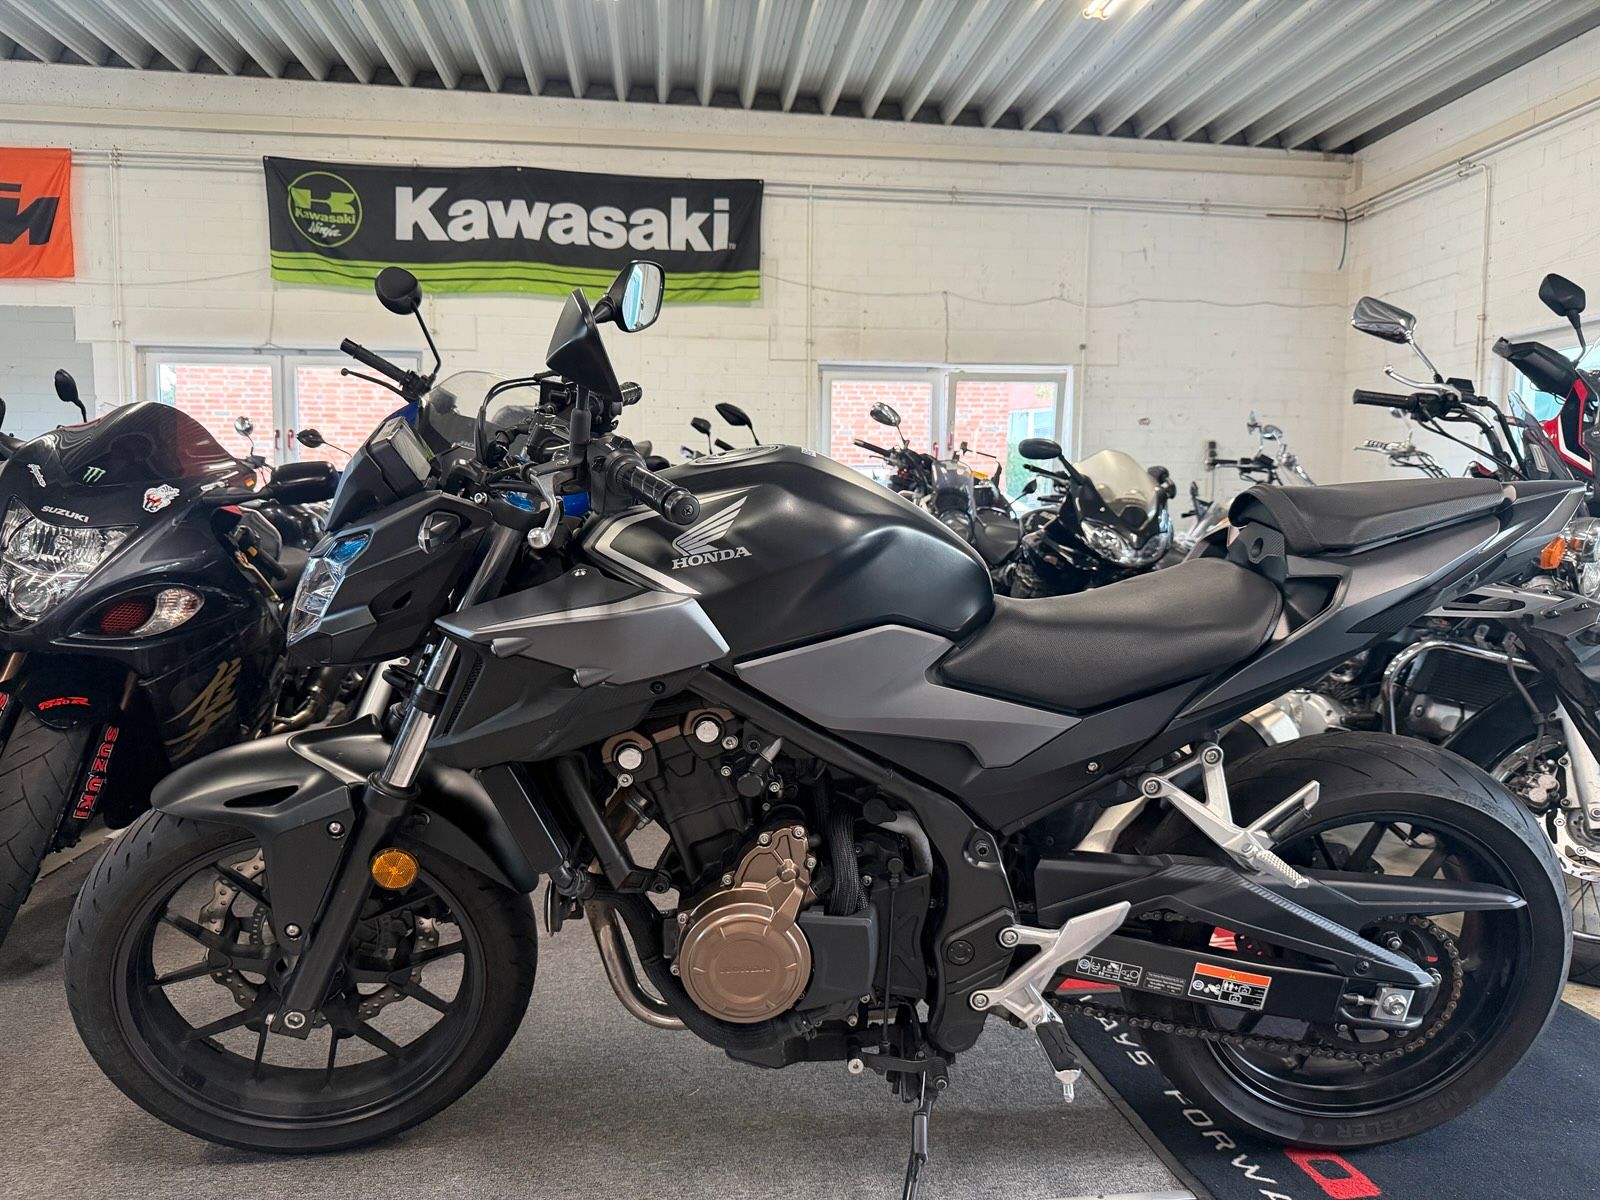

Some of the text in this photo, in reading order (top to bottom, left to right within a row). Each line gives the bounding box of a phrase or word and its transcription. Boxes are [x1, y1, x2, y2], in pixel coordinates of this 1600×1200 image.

[0, 182, 60, 245] M
[295, 207, 356, 225] Kawasaki
[395, 186, 730, 252] Kawasaki
[308, 221, 343, 239] Ninja
[41, 505, 90, 523] SUZUKI
[671, 546, 752, 570] HONDA
[73, 725, 120, 819] SUZUKI
